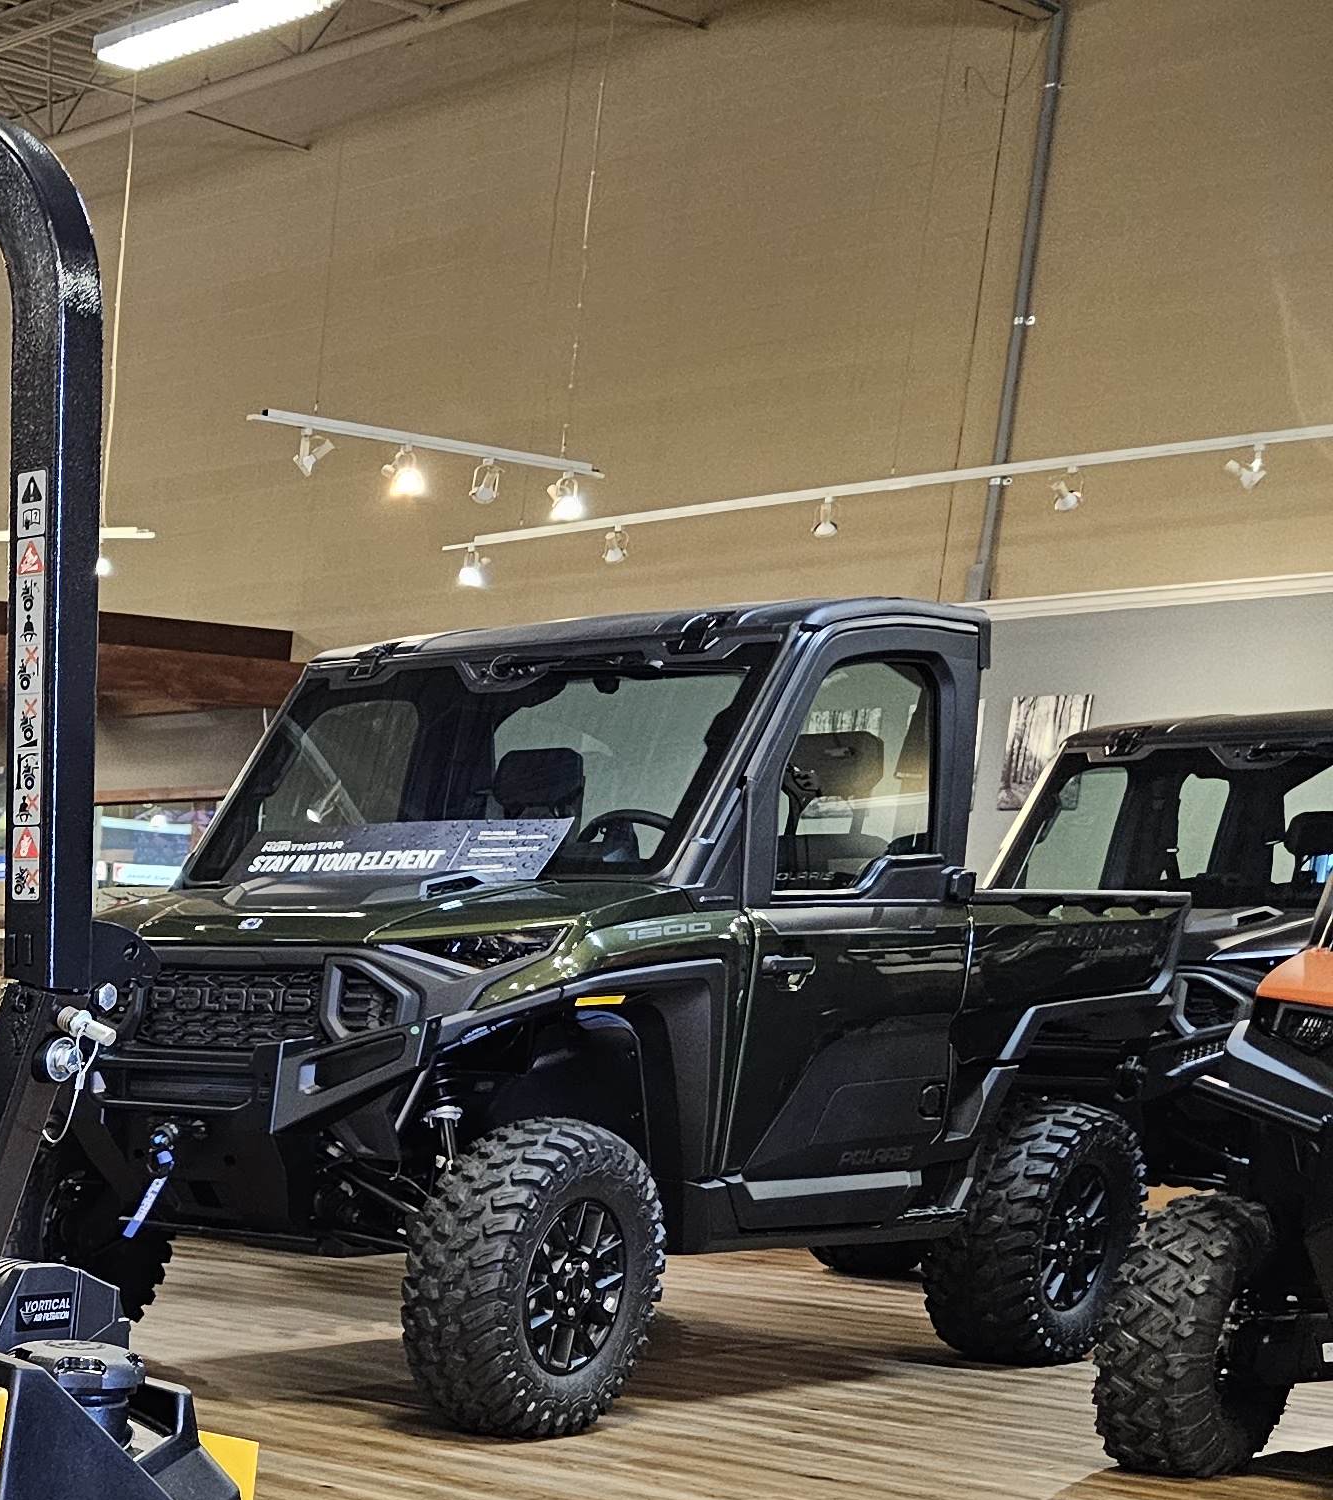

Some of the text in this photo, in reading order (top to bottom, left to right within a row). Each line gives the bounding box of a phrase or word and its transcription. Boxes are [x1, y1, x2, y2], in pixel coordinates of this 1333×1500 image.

[247, 854, 296, 873] STAY
[290, 854, 316, 873] IN
[313, 852, 362, 872] YOUR
[357, 849, 447, 871] ELEMENT
[776, 871, 835, 881] OLARIS
[627, 920, 712, 941] 1500
[151, 986, 312, 1013] POLARIS
[24, 1298, 71, 1313] VORTICAL
